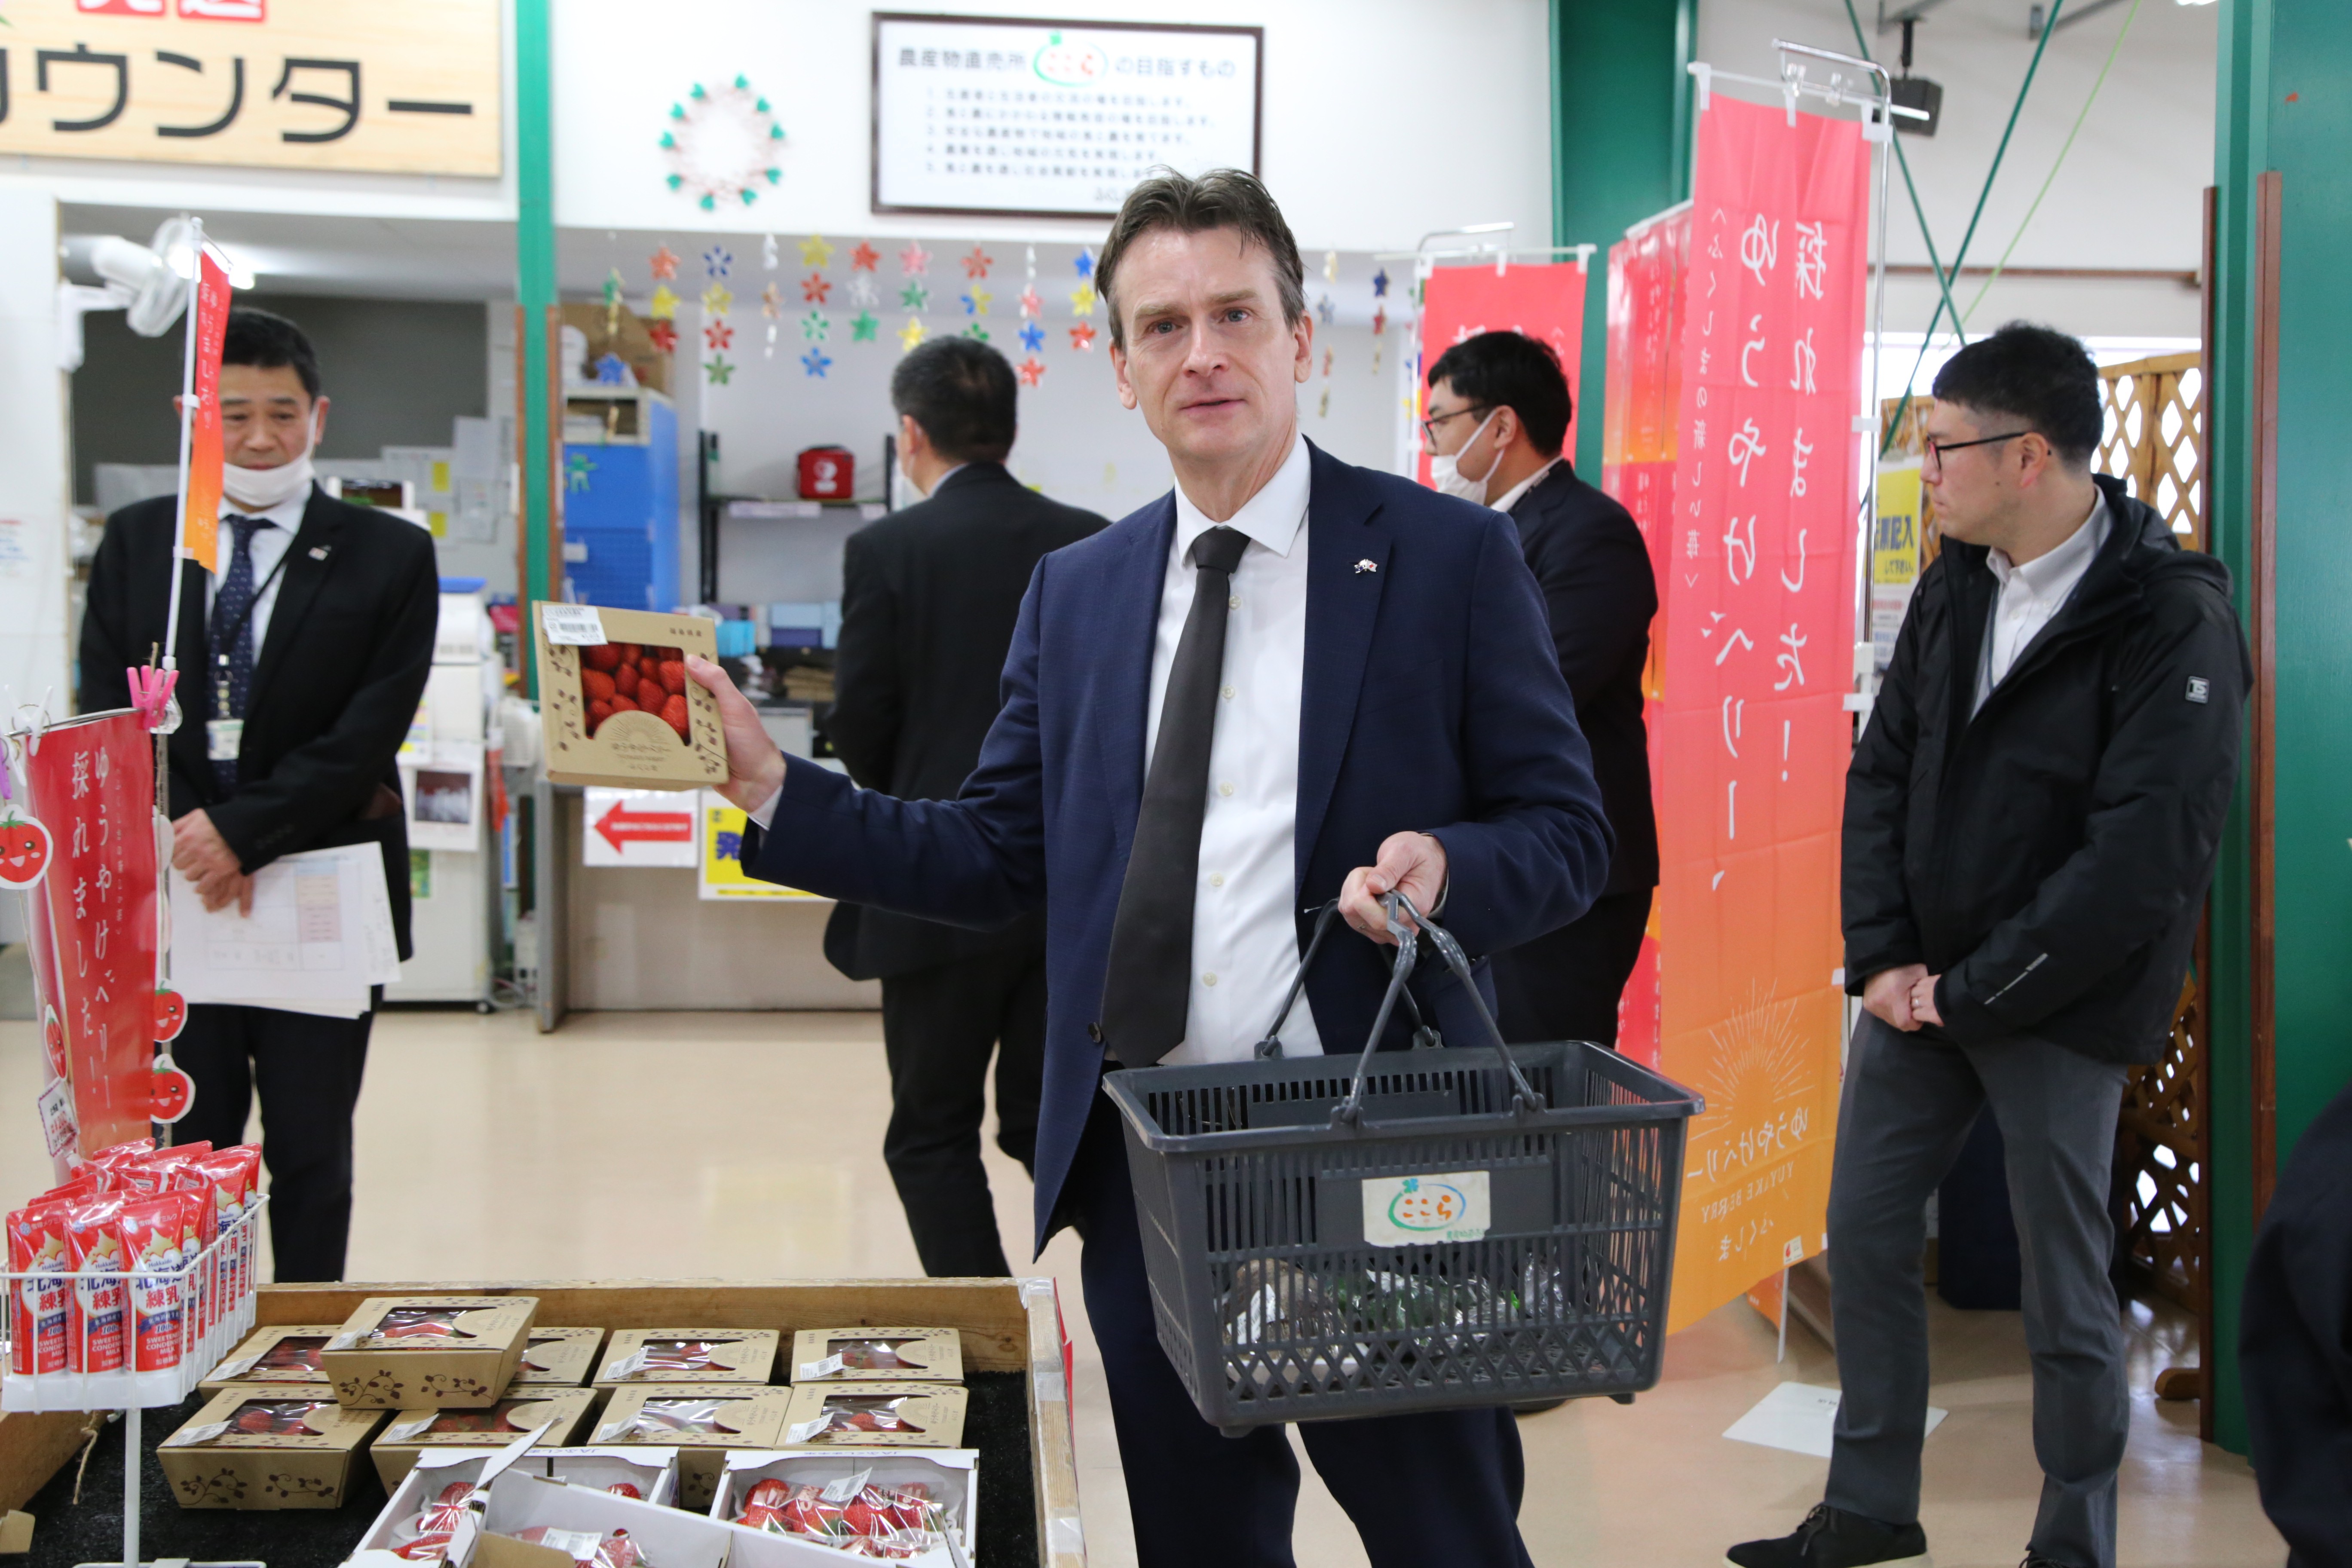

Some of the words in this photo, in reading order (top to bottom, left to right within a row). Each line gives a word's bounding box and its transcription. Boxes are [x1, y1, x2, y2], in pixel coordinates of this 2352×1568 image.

[0, 42, 473, 143] ウンター
[148, 1259, 172, 1268] Hokkaido
[146, 1285, 180, 1309] 練乳
